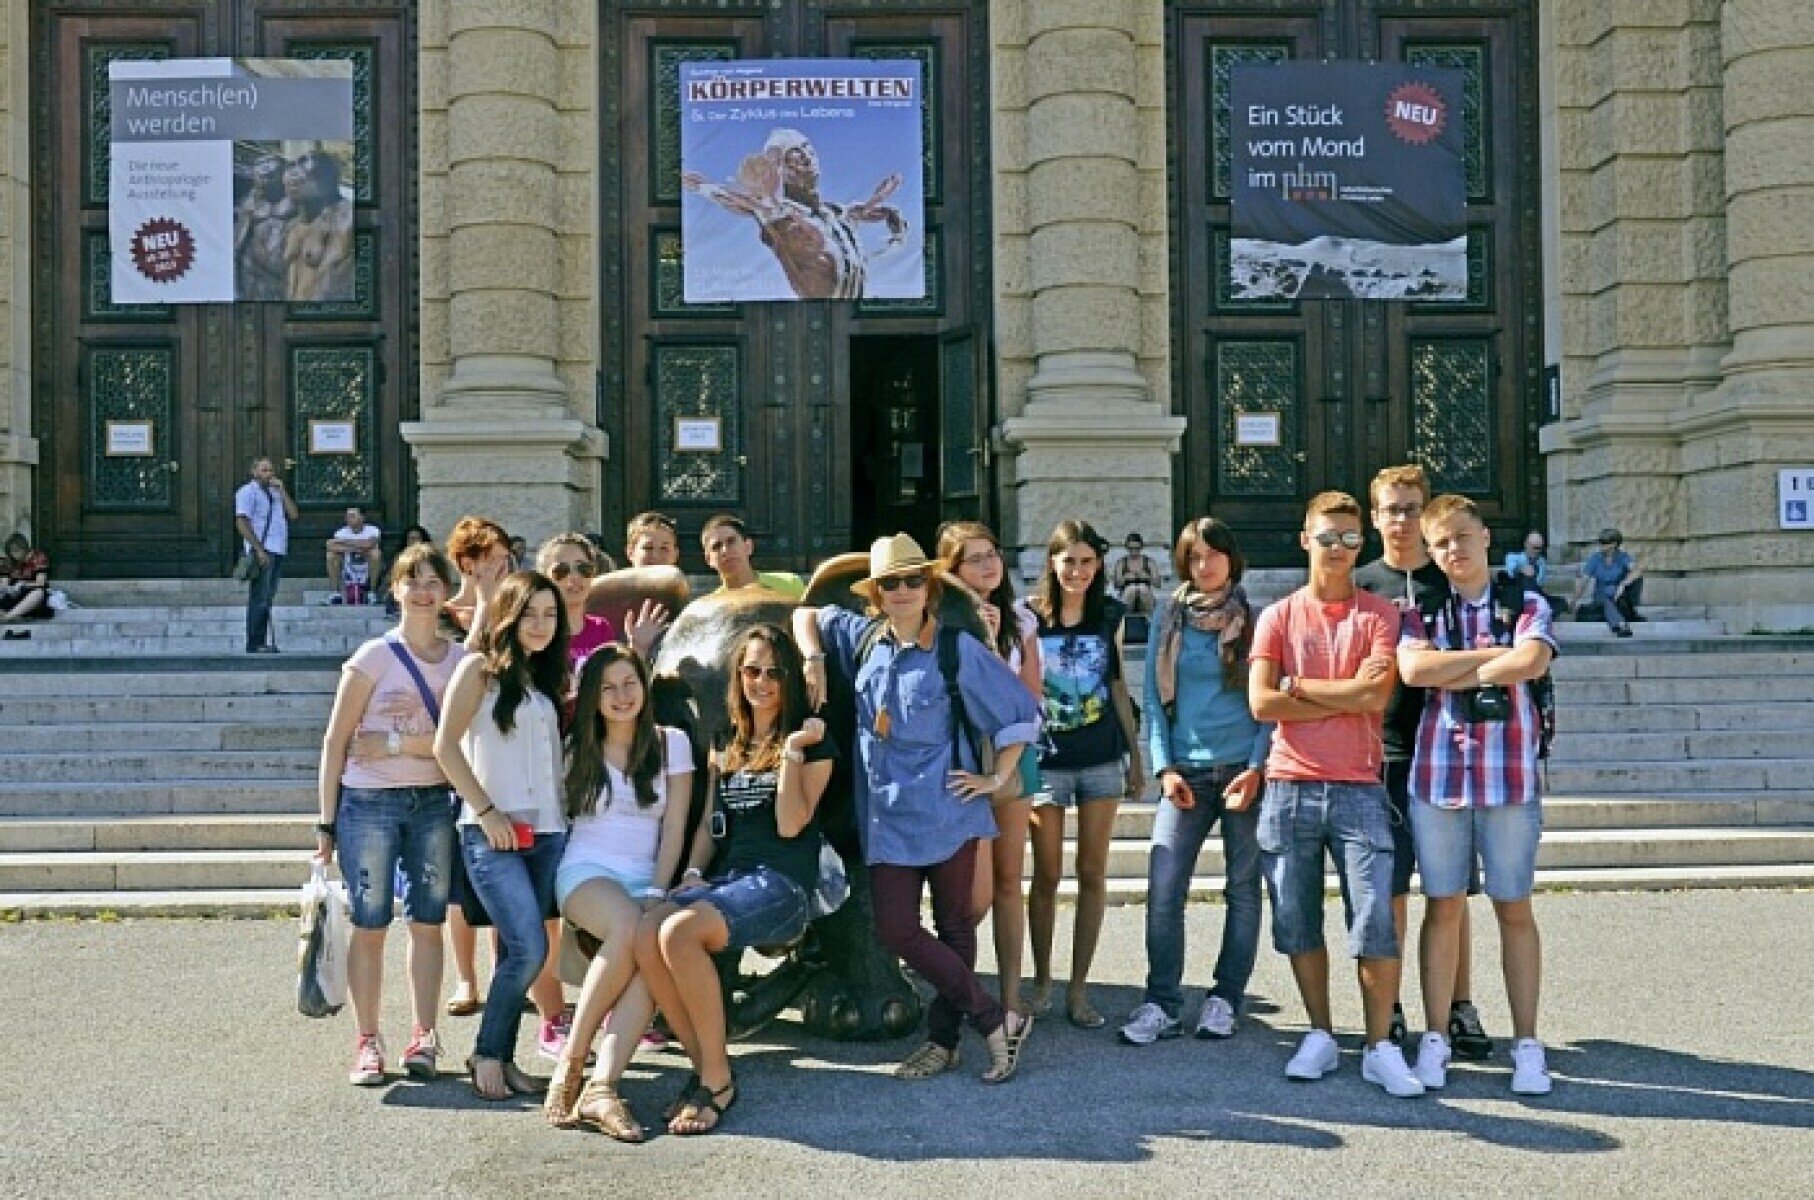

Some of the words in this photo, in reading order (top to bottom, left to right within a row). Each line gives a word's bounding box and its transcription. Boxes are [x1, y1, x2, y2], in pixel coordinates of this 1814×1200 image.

[126, 83, 258, 109] Mensch(en)
[691, 75, 912, 99] KÖRPERWELTEN
[126, 113, 217, 135] werden
[1248, 104, 1279, 126] Ein
[1285, 103, 1344, 126] Stück
[1393, 101, 1438, 126] NEU
[1247, 139, 1295, 157] vom
[1302, 135, 1365, 157] Mond
[1248, 168, 1276, 188] im
[141, 230, 180, 252] NEU
